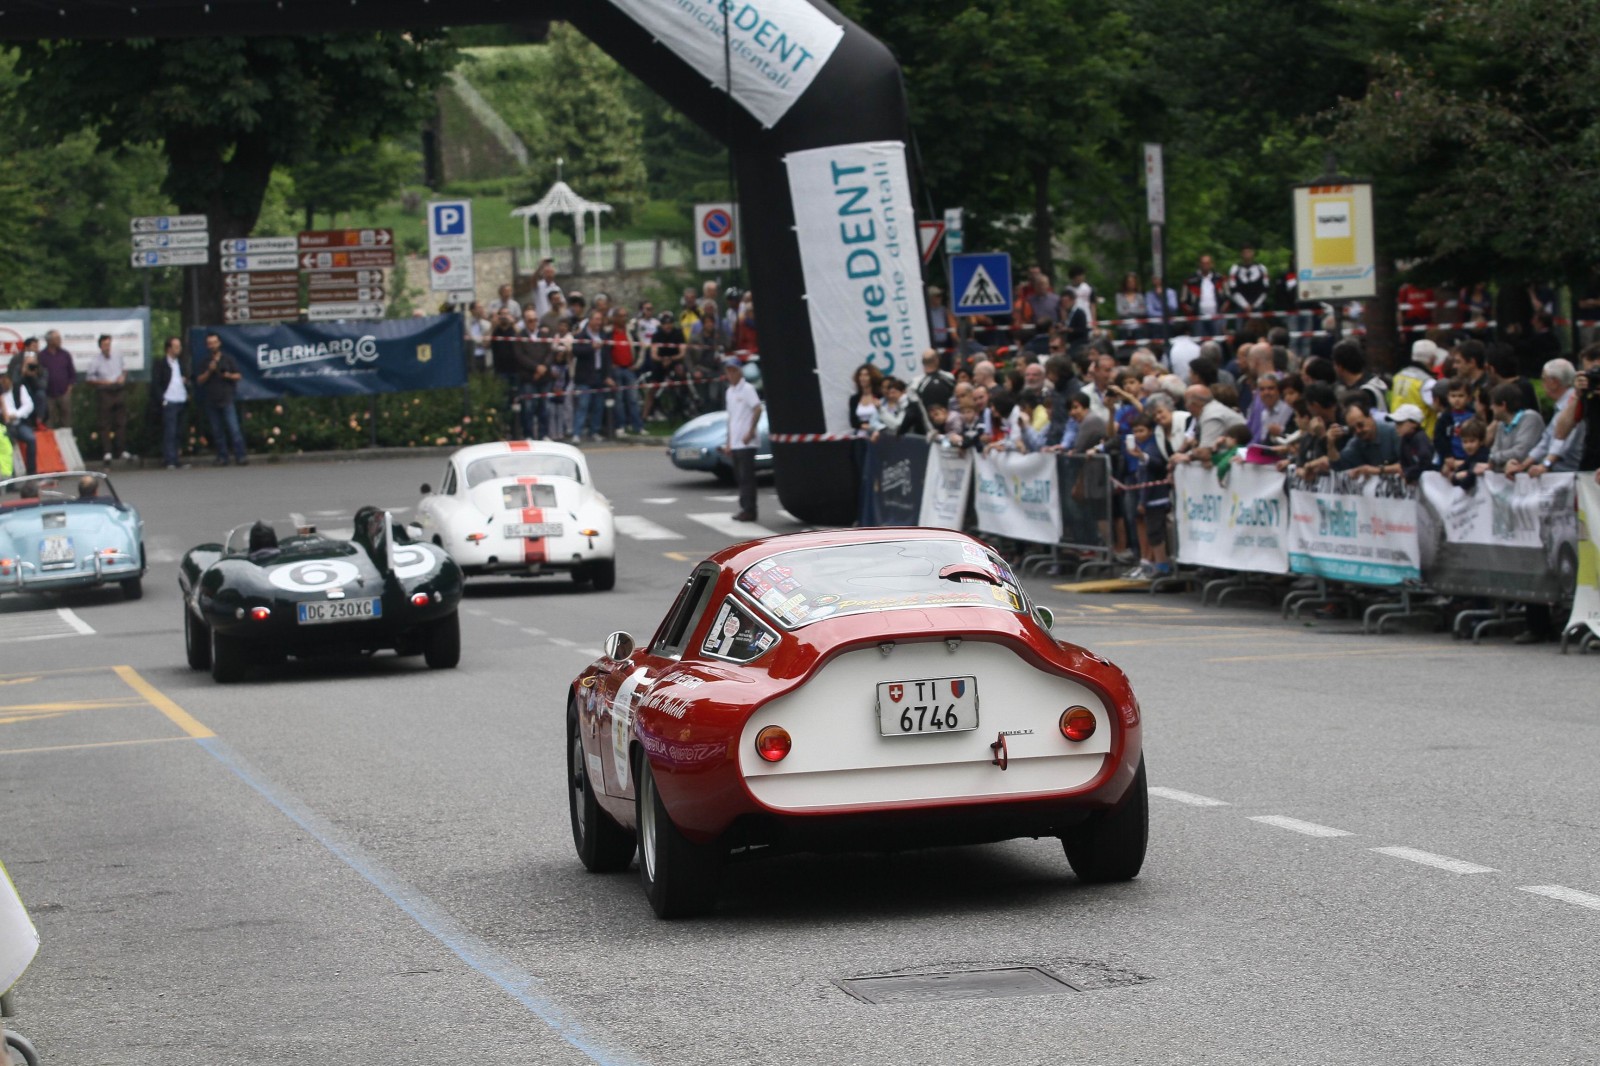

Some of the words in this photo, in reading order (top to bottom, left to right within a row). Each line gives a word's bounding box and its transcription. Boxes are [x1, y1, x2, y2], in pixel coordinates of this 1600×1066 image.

[440, 208, 459, 233] P
[873, 161, 900, 258] dentali
[893, 271, 917, 372] cliniche
[290, 562, 338, 587] 6
[915, 681, 936, 702] TI
[900, 703, 958, 732] 6746
